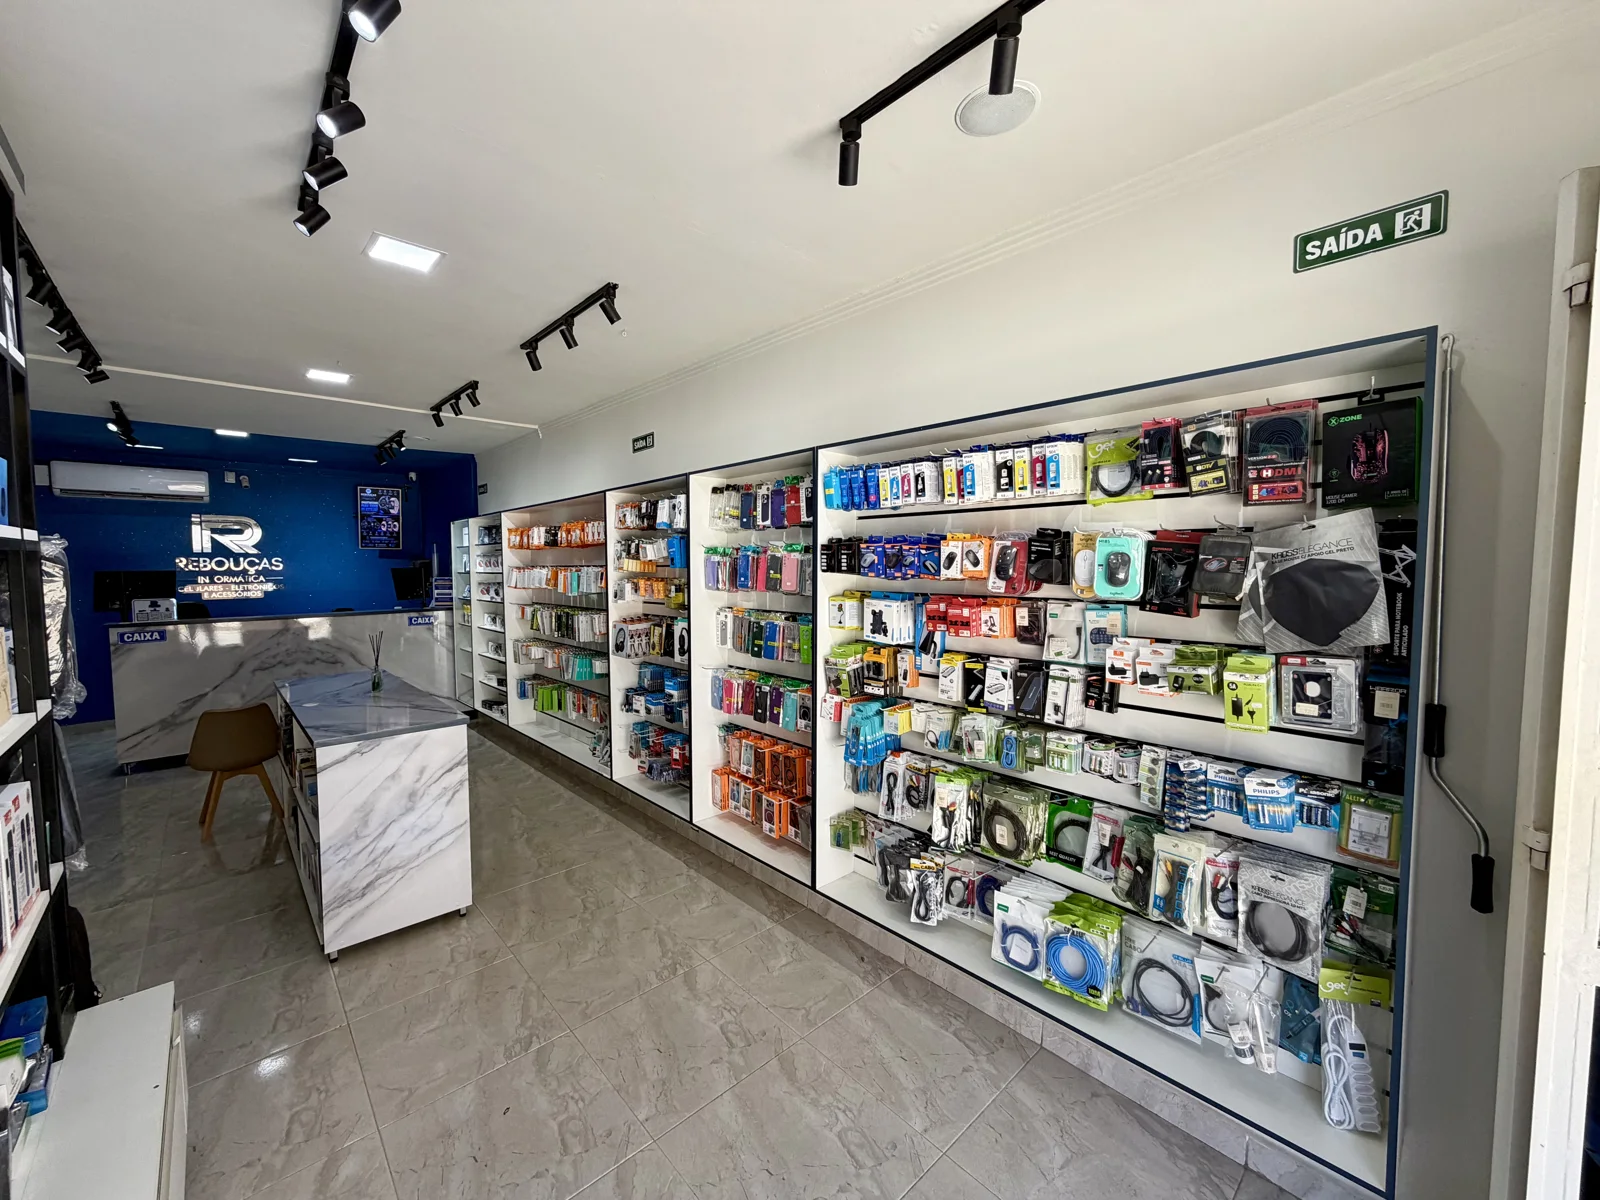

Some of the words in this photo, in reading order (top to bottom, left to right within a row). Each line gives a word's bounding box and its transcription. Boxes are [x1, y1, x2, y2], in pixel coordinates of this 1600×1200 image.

[1305, 223, 1383, 261] SAÍDA
[1340, 414, 1363, 423] ZONE
[1089, 440, 1116, 459] get
[1260, 467, 1303, 479] HDMI
[175, 557, 284, 574] REBOUÇAS
[197, 574, 266, 583] INORMÁTICA
[210, 590, 262, 599] ACESSÓRIOS
[1395, 592, 1403, 620] NOTEBOOK
[412, 616, 435, 625] CAIXA
[123, 631, 161, 642] CAIXA
[1401, 624, 1409, 657] ARTICULADO
[1214, 774, 1239, 783] PHILIPS
[1252, 787, 1281, 796] PHILIPS
[1058, 853, 1077, 863] QUALITY
[1319, 981, 1347, 994] get
